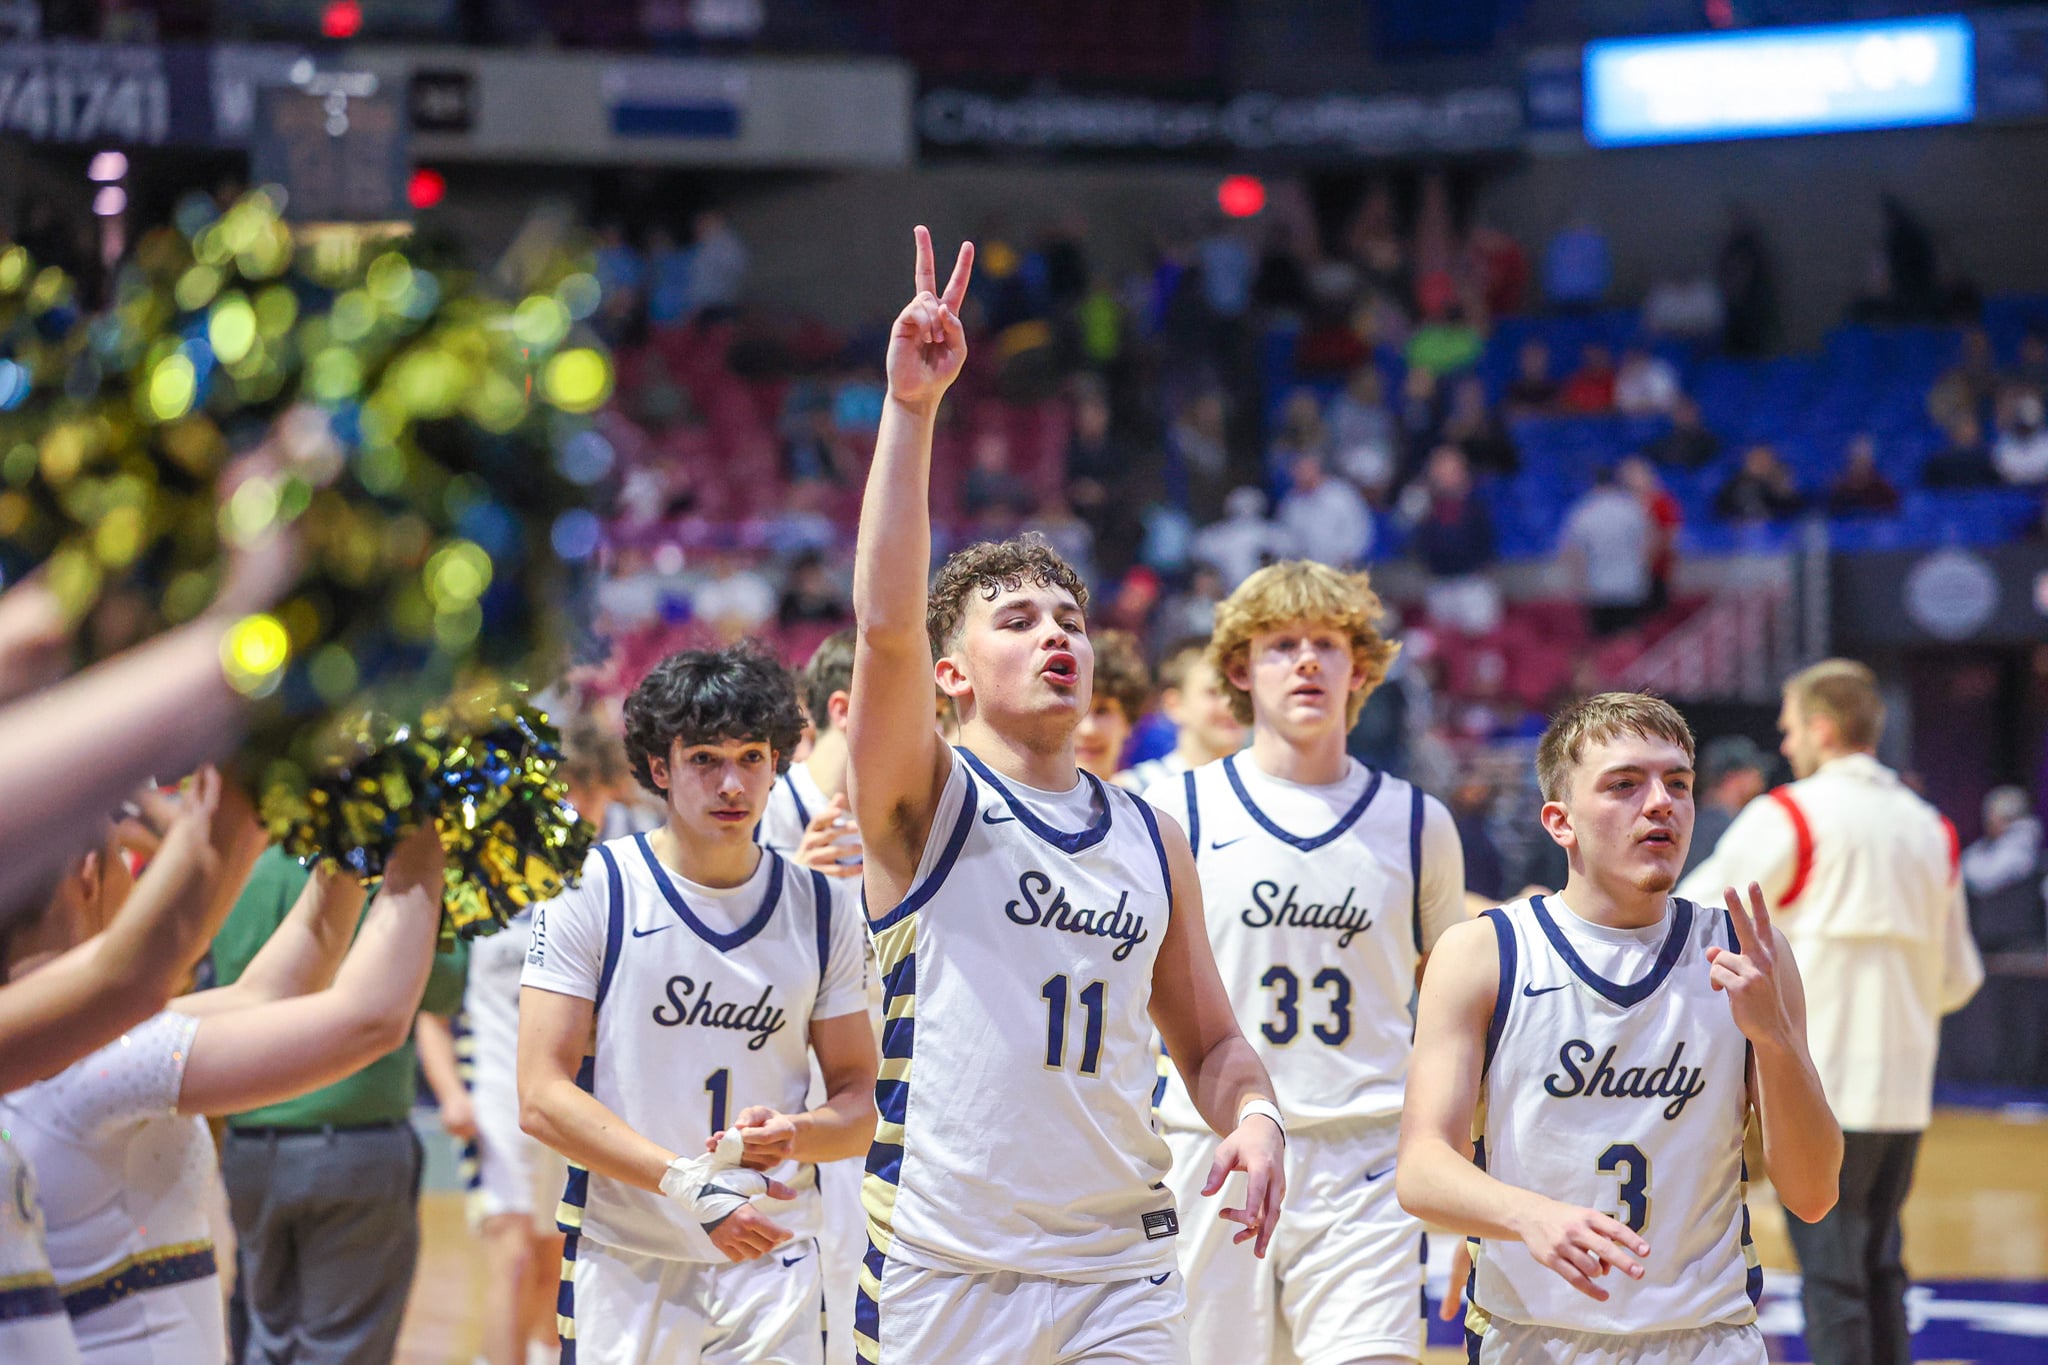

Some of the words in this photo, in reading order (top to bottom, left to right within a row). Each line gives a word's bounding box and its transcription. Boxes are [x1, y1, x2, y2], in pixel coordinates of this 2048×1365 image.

[1004, 869, 1149, 962] Shady
[1240, 880, 1372, 949] Shady
[652, 975, 786, 1052] Shady
[1040, 972, 1108, 1079] 11
[1259, 964, 1354, 1050] 33
[703, 1066, 732, 1136] 1
[1543, 1038, 1706, 1121] Shady
[1595, 1141, 1652, 1238] 3
